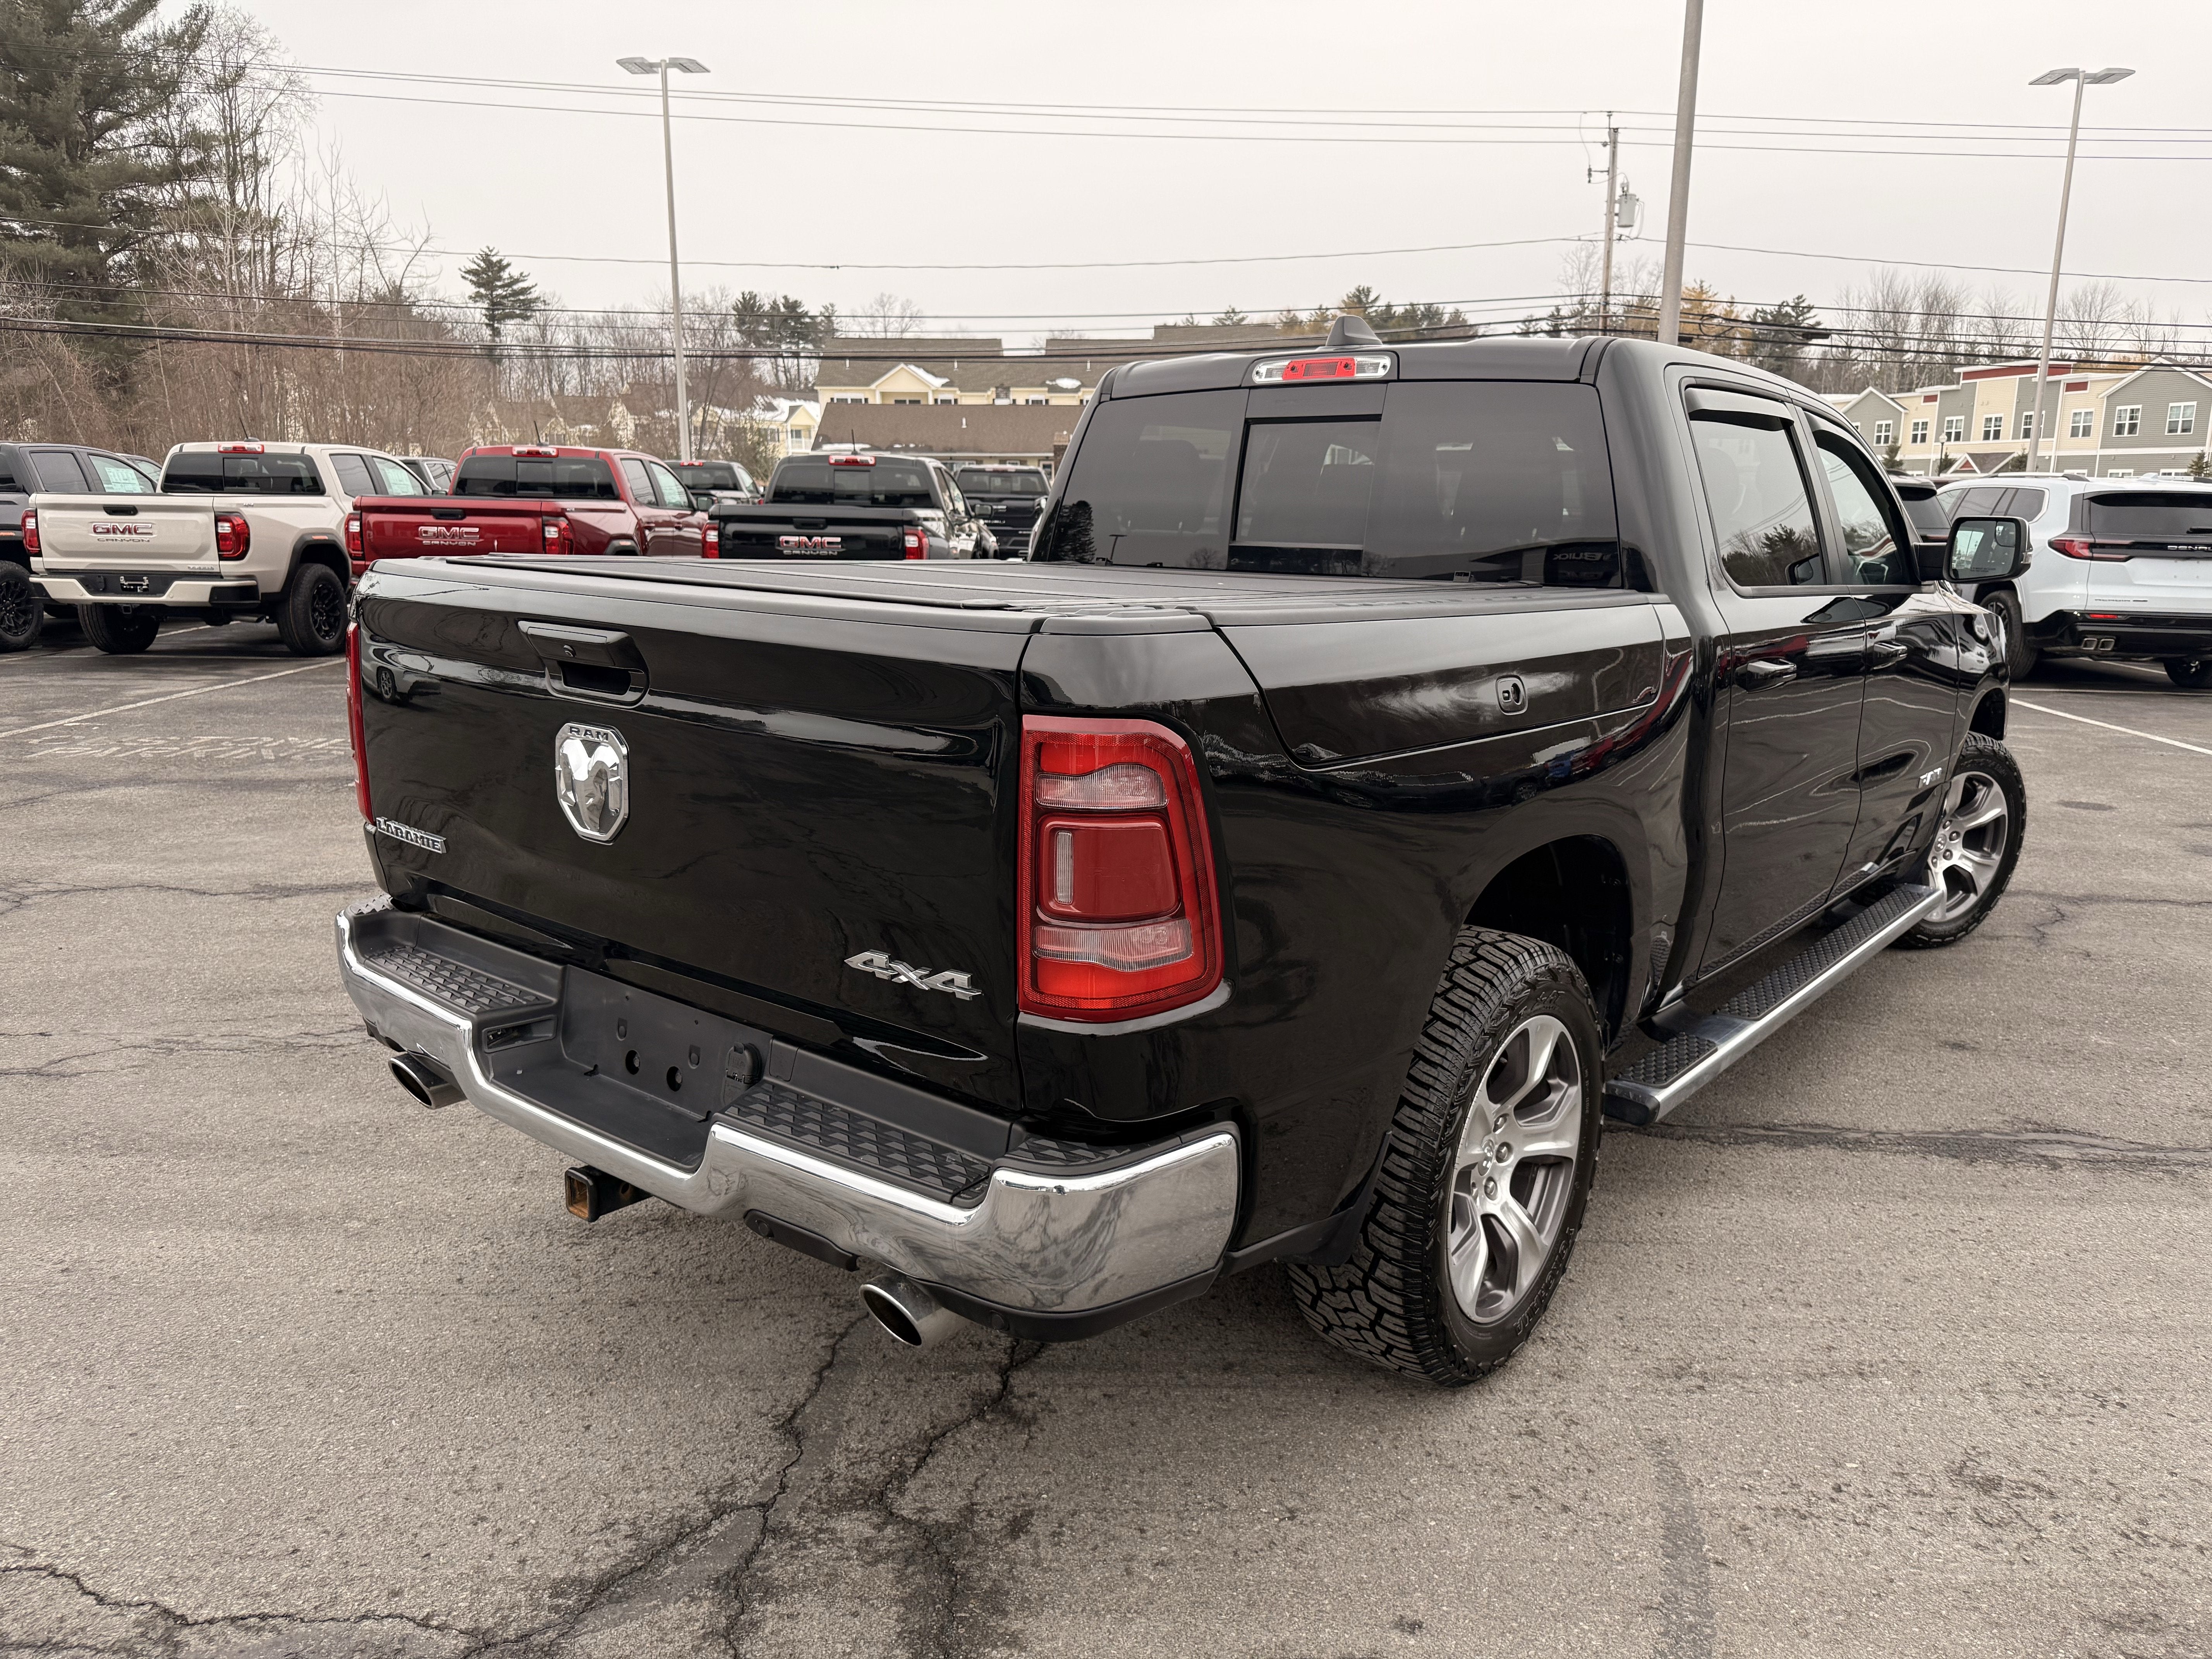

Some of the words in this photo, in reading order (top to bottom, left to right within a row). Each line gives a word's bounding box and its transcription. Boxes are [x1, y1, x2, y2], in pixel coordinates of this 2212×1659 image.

[93, 523, 153, 535] GMC
[419, 526, 479, 539] GMC
[779, 536, 841, 548] GMC
[568, 726, 609, 742] RAM
[29, 735, 350, 749] CUSTOME
[376, 817, 447, 854] LARAMIE
